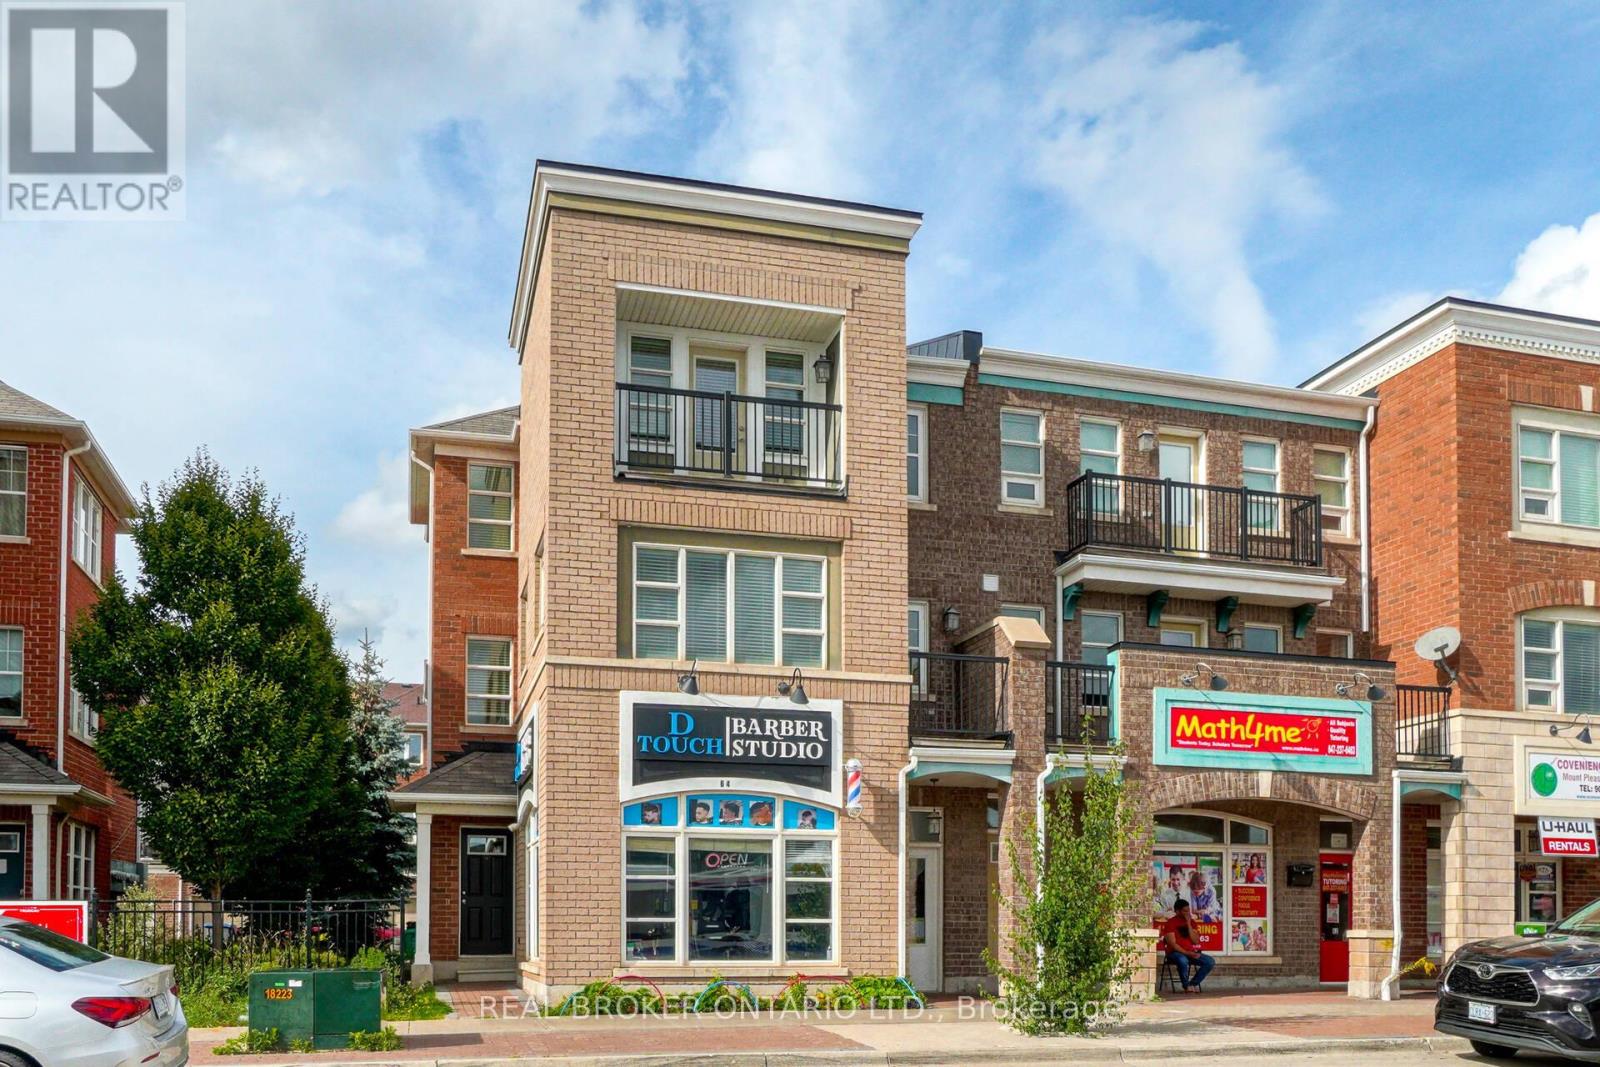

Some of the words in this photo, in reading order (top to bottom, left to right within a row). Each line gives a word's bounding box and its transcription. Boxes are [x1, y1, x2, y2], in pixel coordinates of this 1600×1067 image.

[668, 712, 695, 736] D
[731, 717, 829, 741] BARBER
[1176, 714, 1302, 748] Math4me
[637, 735, 724, 755] TOUCH
[732, 739, 823, 760] STUDIO
[1562, 773, 1582, 782] Mount
[1542, 821, 1593, 834] U-HAUL
[1548, 841, 1591, 852] RENTALS
[705, 852, 749, 869] OPEN
[264, 988, 294, 1000] 18223
